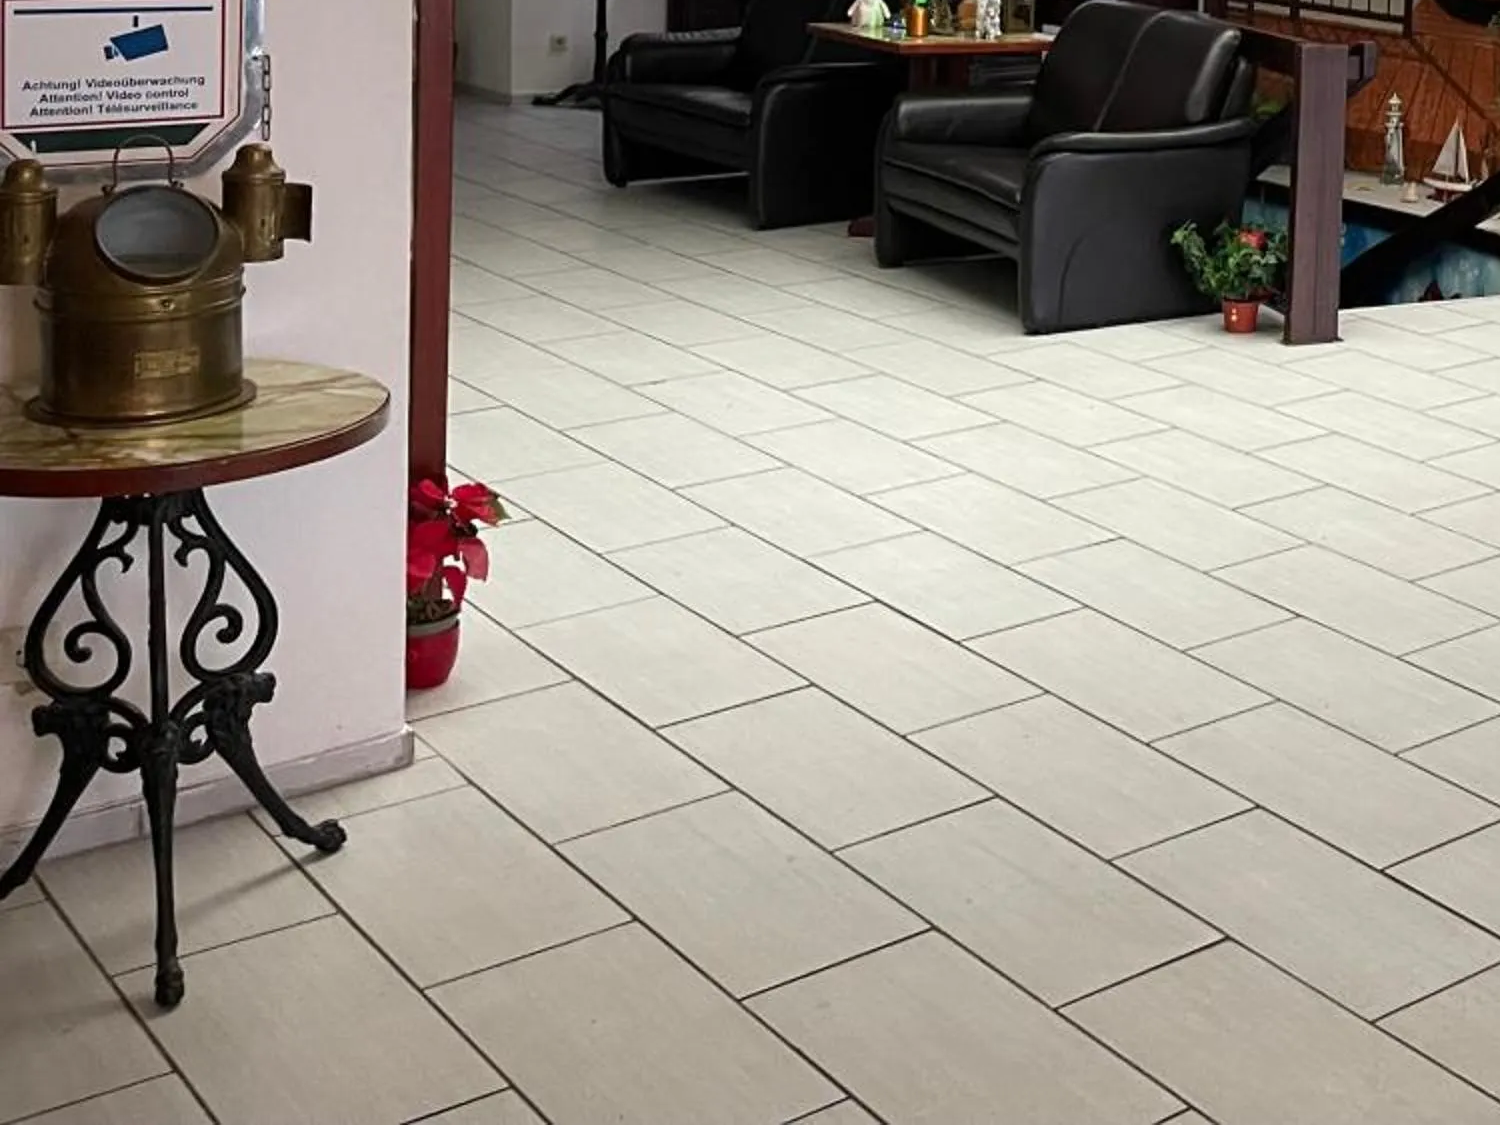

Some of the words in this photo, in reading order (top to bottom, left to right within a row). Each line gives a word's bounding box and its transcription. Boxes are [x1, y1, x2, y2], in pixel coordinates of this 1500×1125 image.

[22, 79, 81, 92] Achtung!
[86, 76, 206, 89] Videoüberwachung
[39, 91, 102, 103] Attention!
[106, 91, 142, 101] Video
[145, 88, 189, 100] control
[29, 104, 93, 117] Attention!
[97, 101, 199, 114] Télésurveillance
